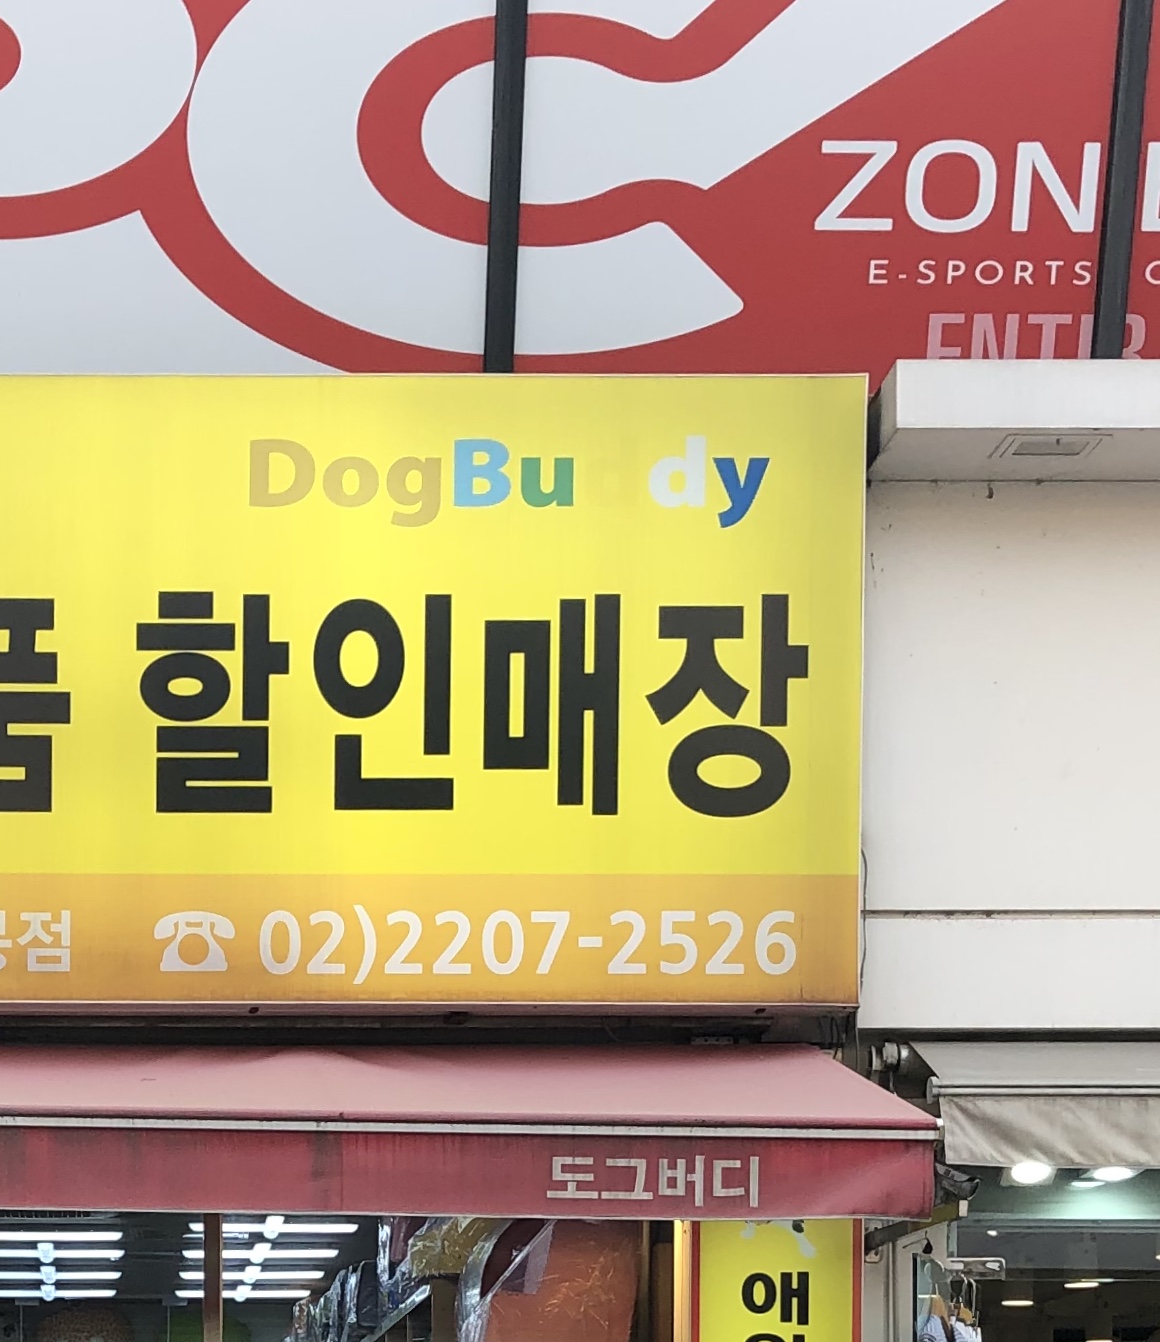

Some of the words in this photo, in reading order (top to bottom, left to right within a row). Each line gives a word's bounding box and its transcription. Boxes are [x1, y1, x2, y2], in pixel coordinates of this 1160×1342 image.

[868, 260, 1093, 286] E-SPORTS
[136, 591, 810, 818] 할인매장
[259, 908, 798, 980] 02)2207-2526
[546, 1156, 760, 1208] 도그버디
